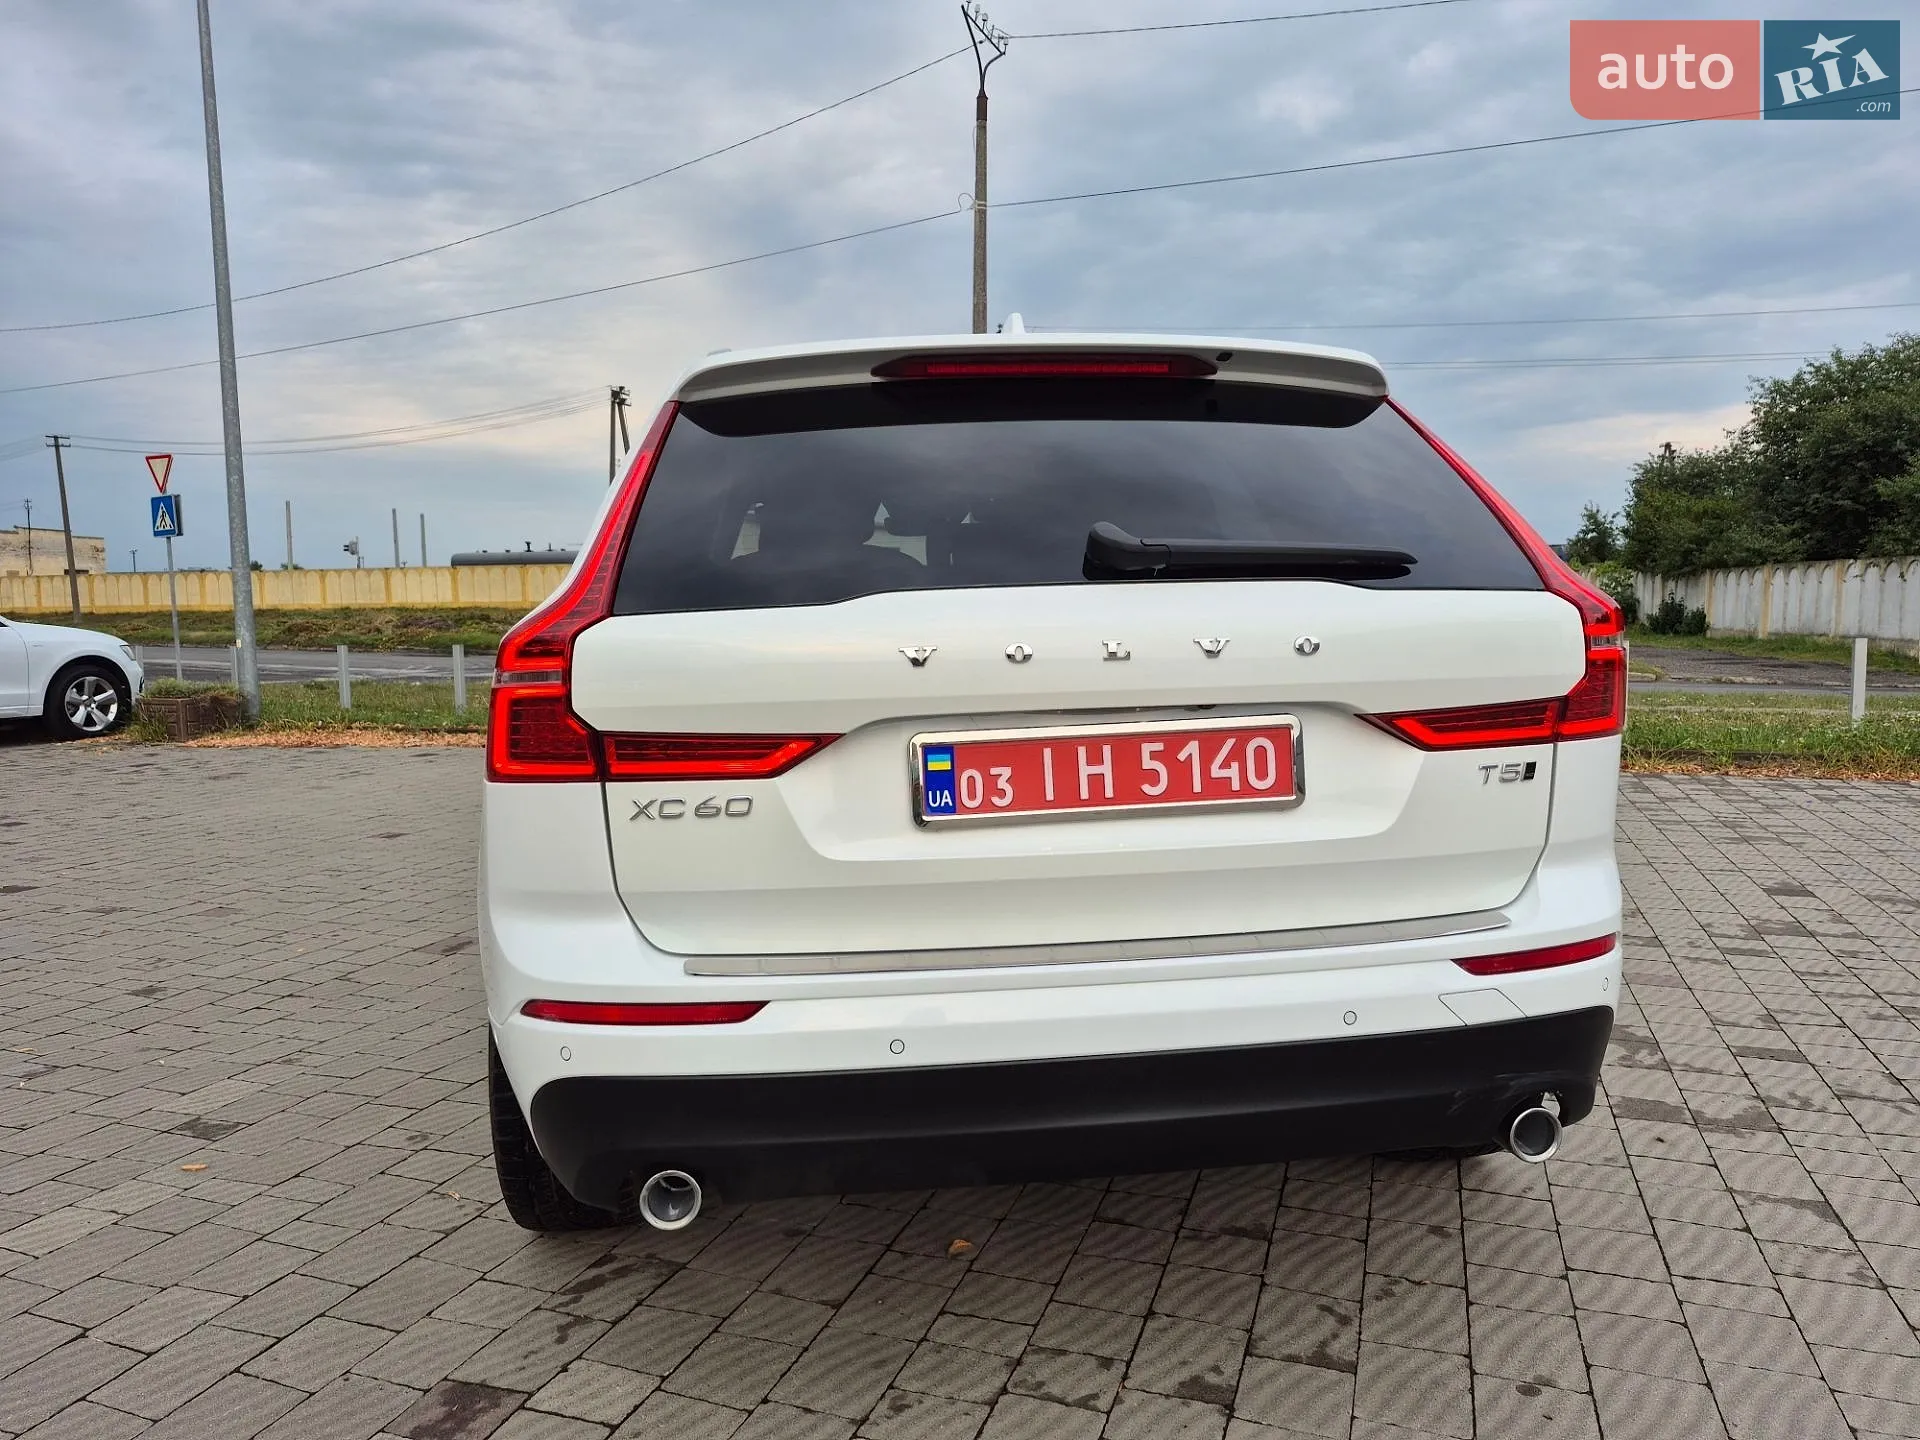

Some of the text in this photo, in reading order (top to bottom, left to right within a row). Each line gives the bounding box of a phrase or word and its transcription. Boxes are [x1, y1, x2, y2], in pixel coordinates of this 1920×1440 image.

[899, 635, 1321, 668] VOLVO
[960, 737, 1276, 809] 03 IH 5140
[928, 789, 953, 807] UA
